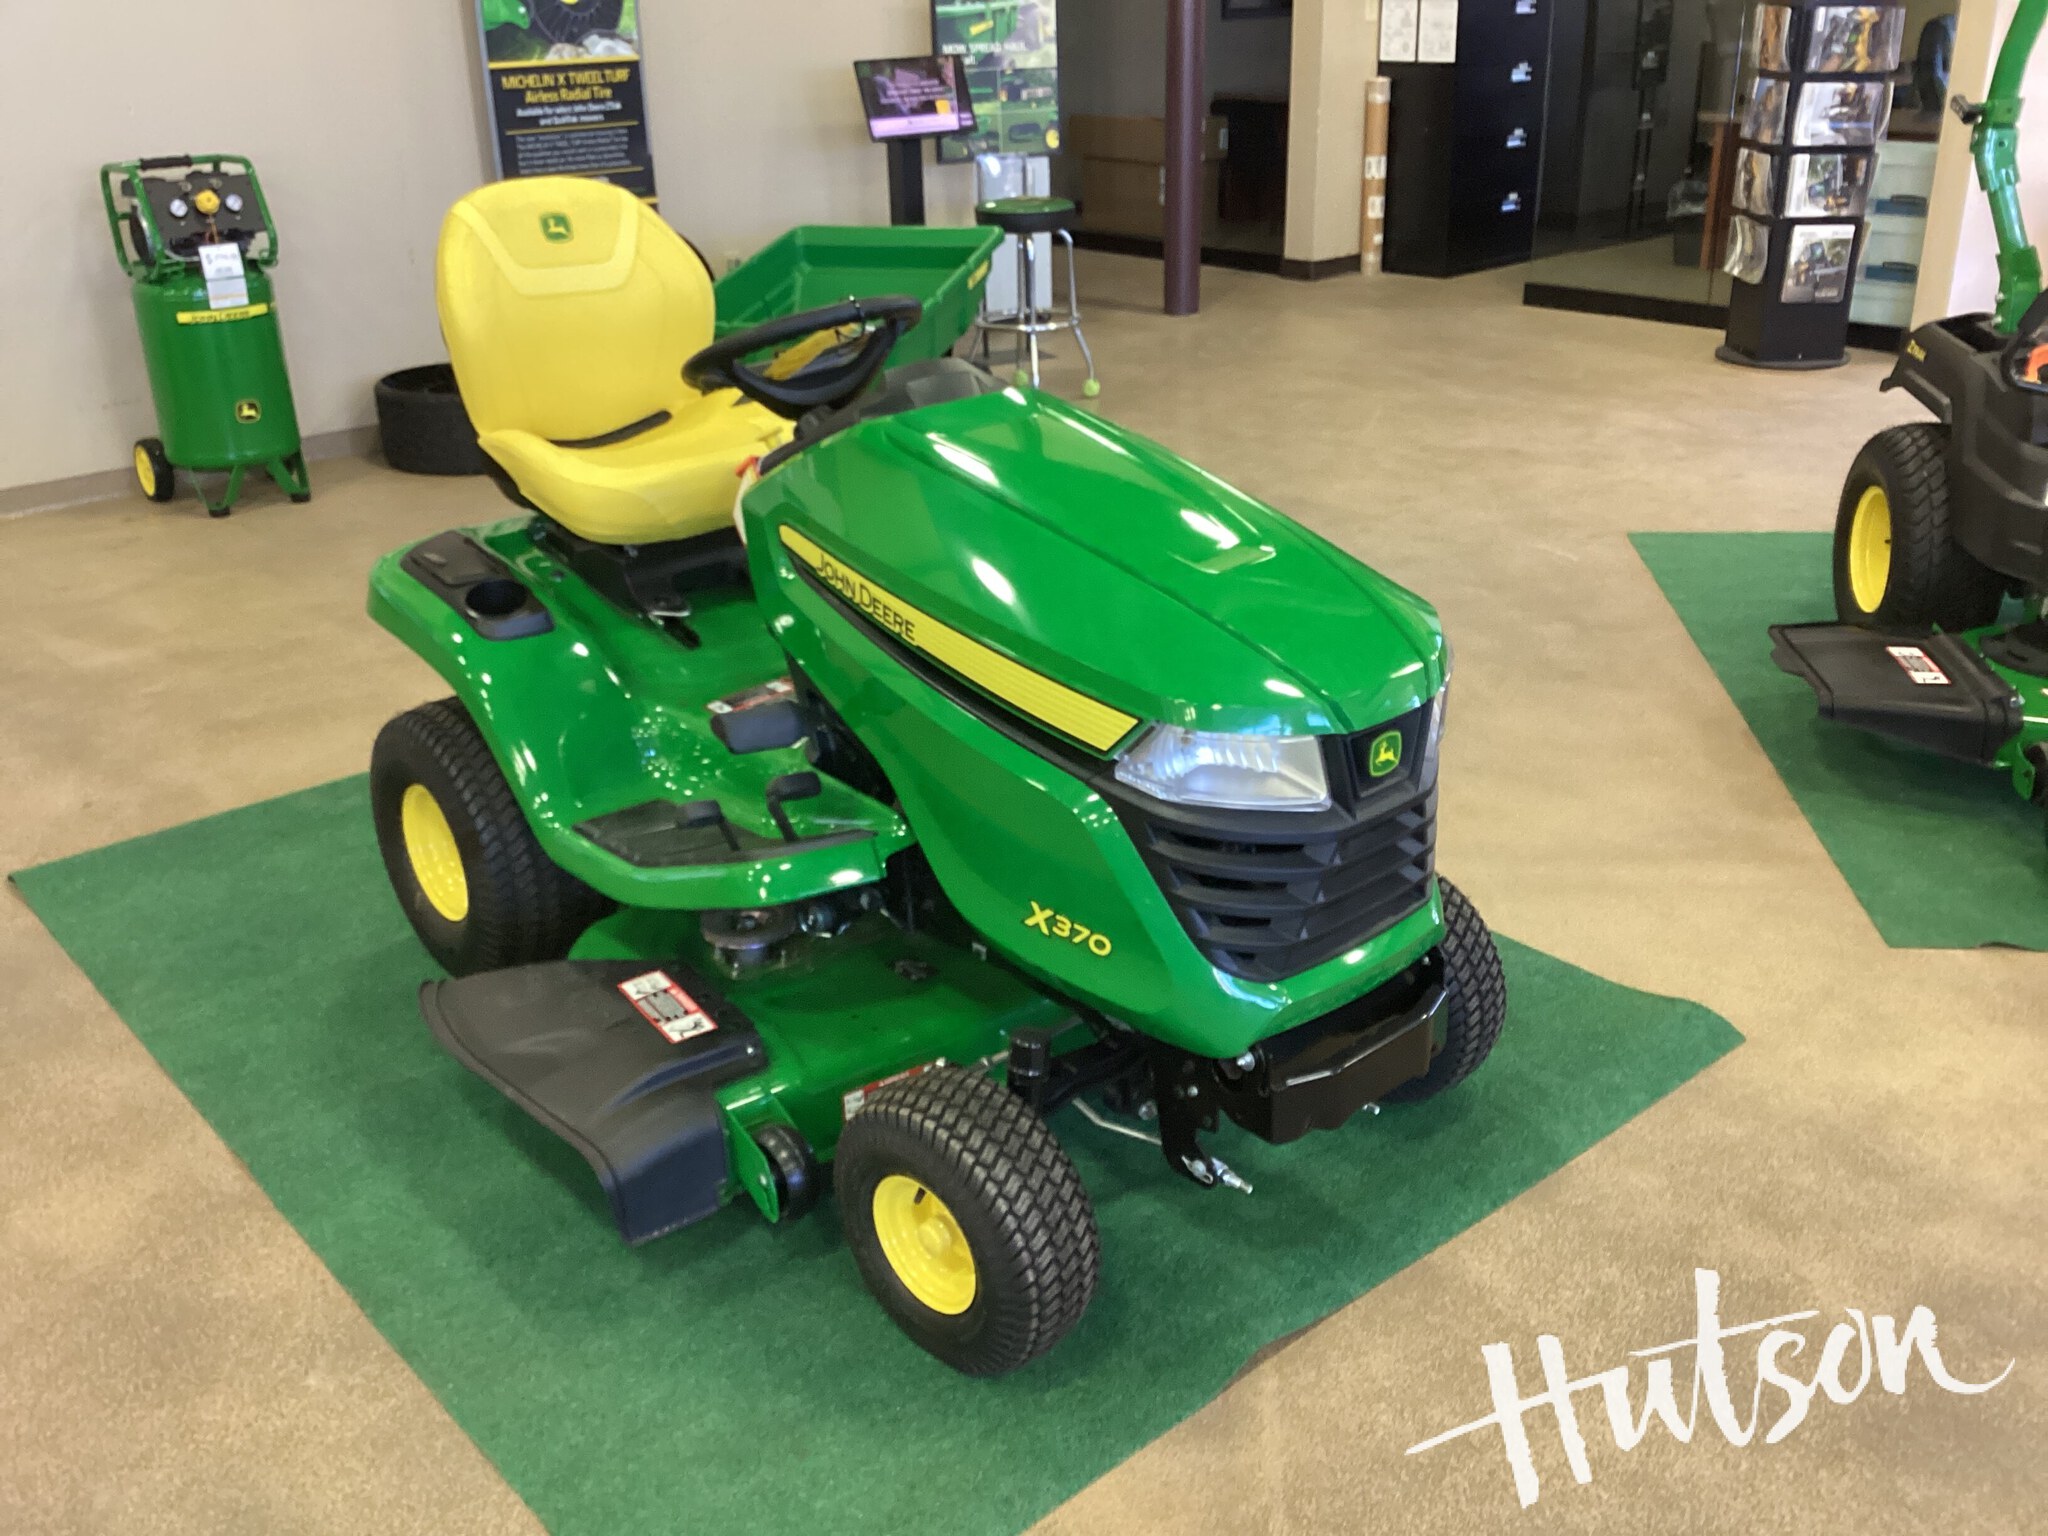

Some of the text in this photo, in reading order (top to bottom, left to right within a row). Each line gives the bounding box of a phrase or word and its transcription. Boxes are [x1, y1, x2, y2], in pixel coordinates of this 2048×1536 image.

[502, 68, 630, 90] MICHELIN X TWEEL TURF
[525, 86, 613, 104] Airless Radial Tire
[816, 552, 915, 642] JOHN DEERE
[1024, 900, 1112, 956] X370
